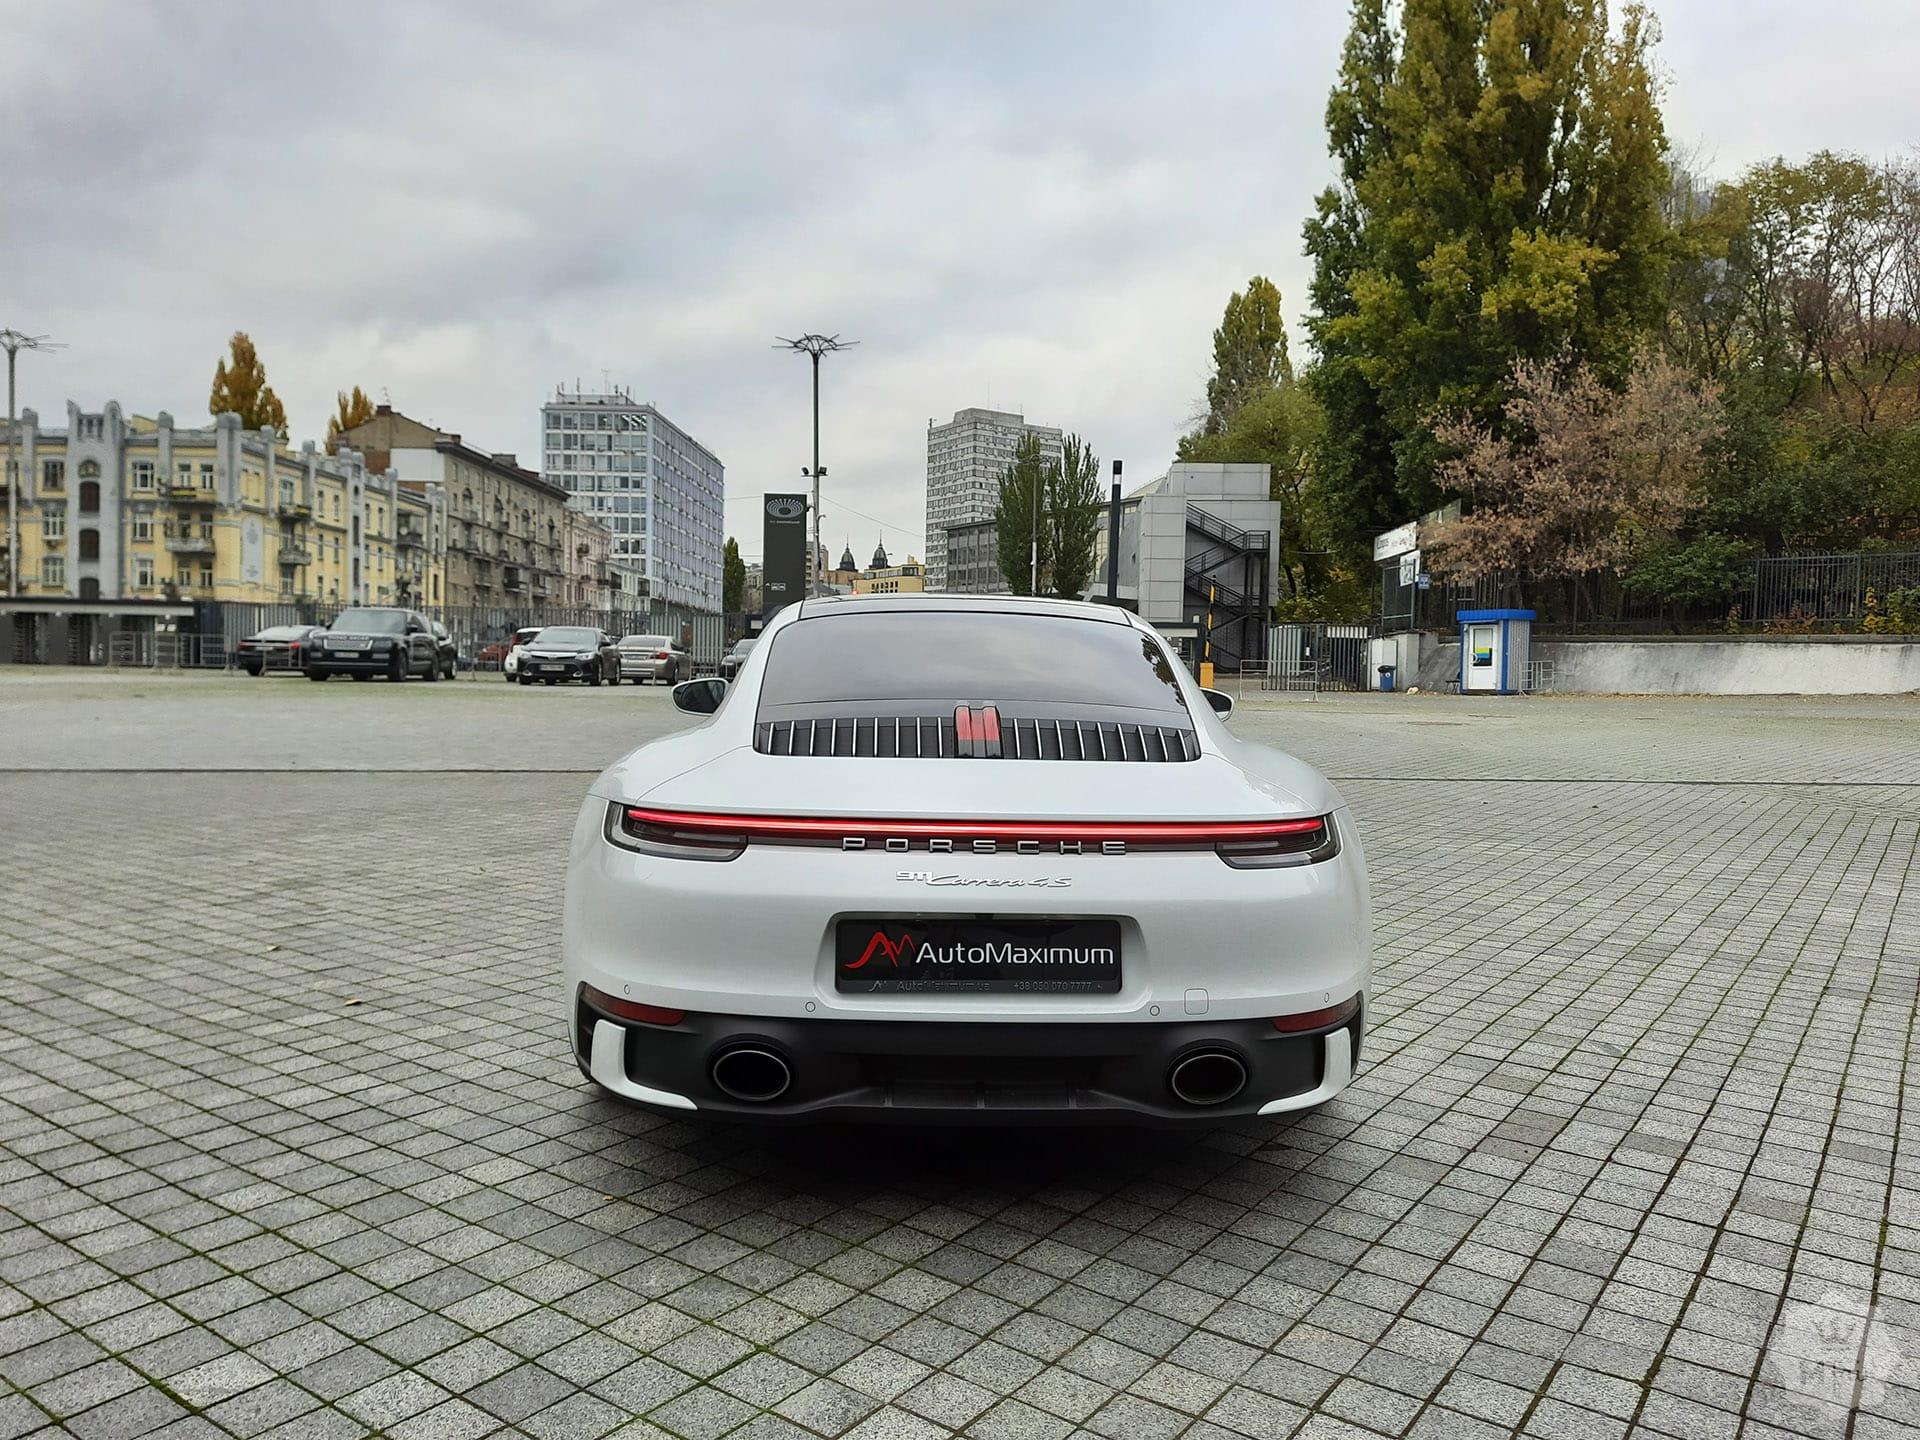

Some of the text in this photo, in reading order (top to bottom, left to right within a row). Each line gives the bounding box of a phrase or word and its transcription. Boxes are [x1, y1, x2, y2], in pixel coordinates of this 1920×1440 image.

[842, 837, 1126, 855] PORSCHE
[896, 871, 1072, 888] 911 Carrera 4S
[915, 942, 1114, 964] AutoMaximum
